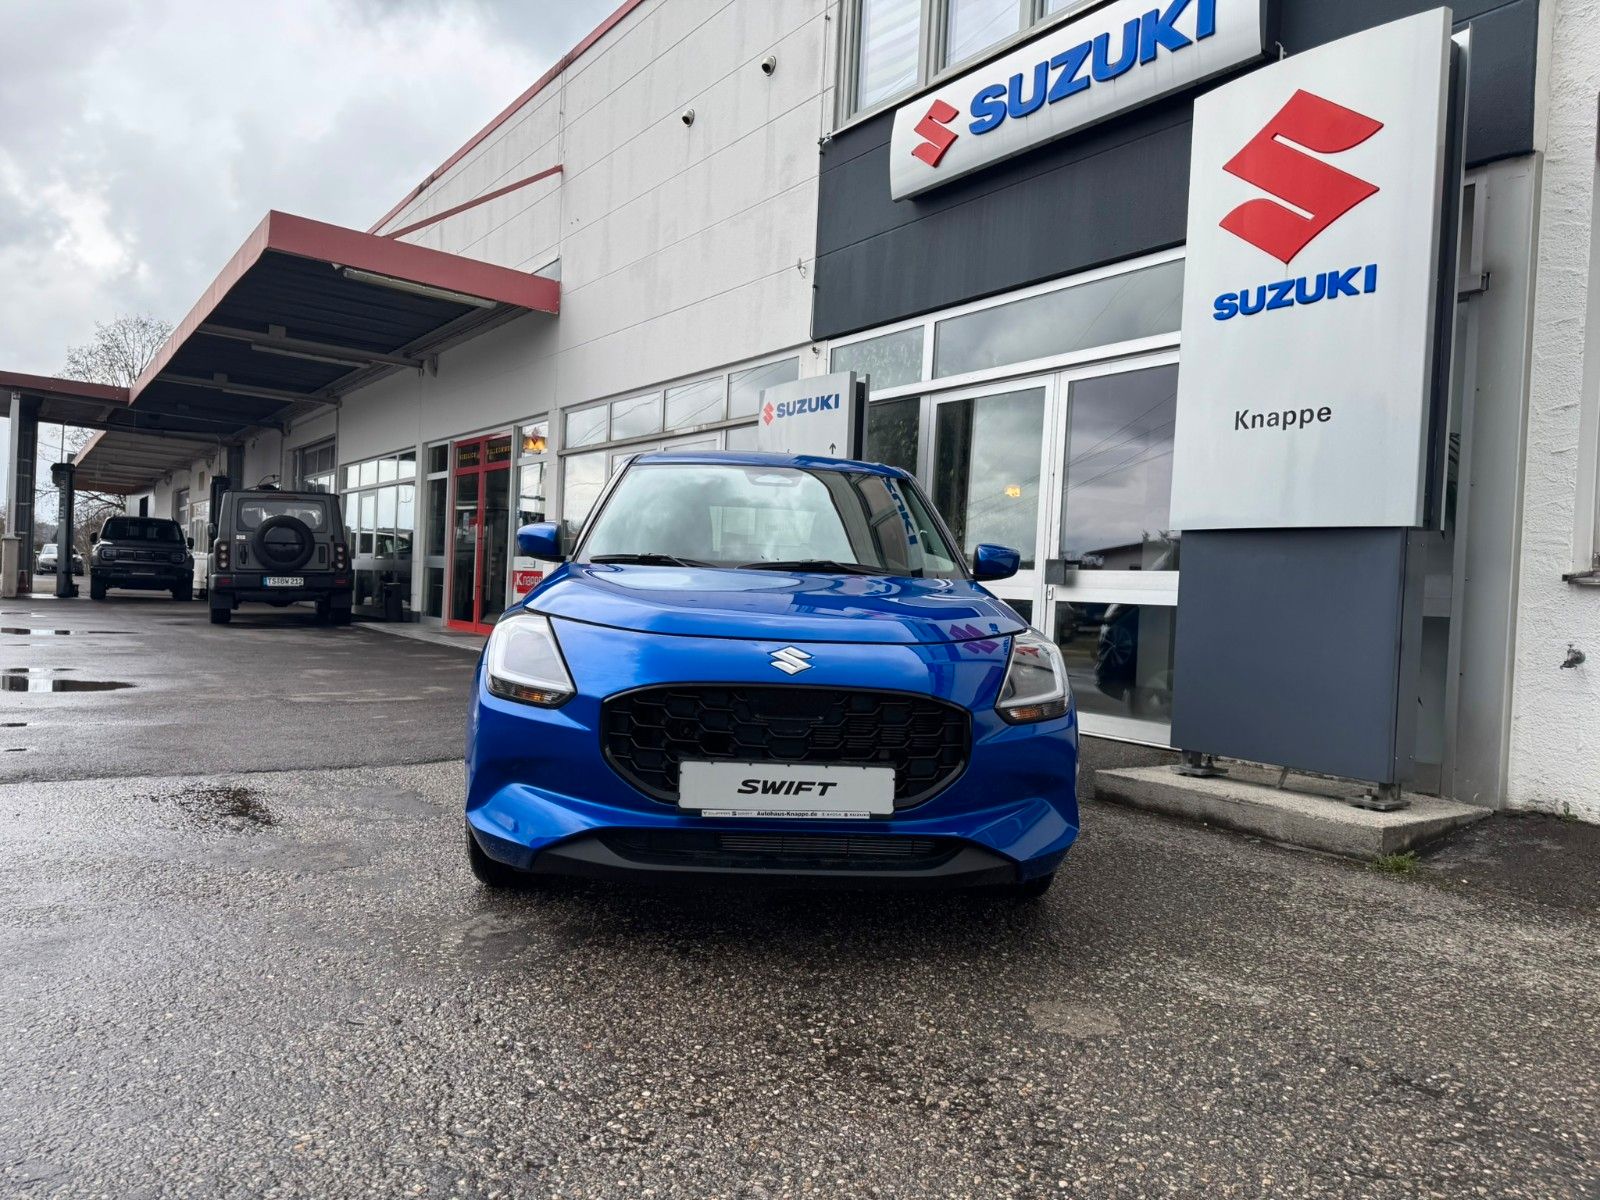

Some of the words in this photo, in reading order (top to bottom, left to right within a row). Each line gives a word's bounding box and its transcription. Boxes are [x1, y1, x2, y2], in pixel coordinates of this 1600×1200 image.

[968, 0, 1216, 136] SUZUKI
[1213, 263, 1378, 321] SUZUKI
[776, 393, 840, 419] SUZUKI
[1234, 405, 1332, 431] Knappe
[737, 779, 838, 797] SWIFT
